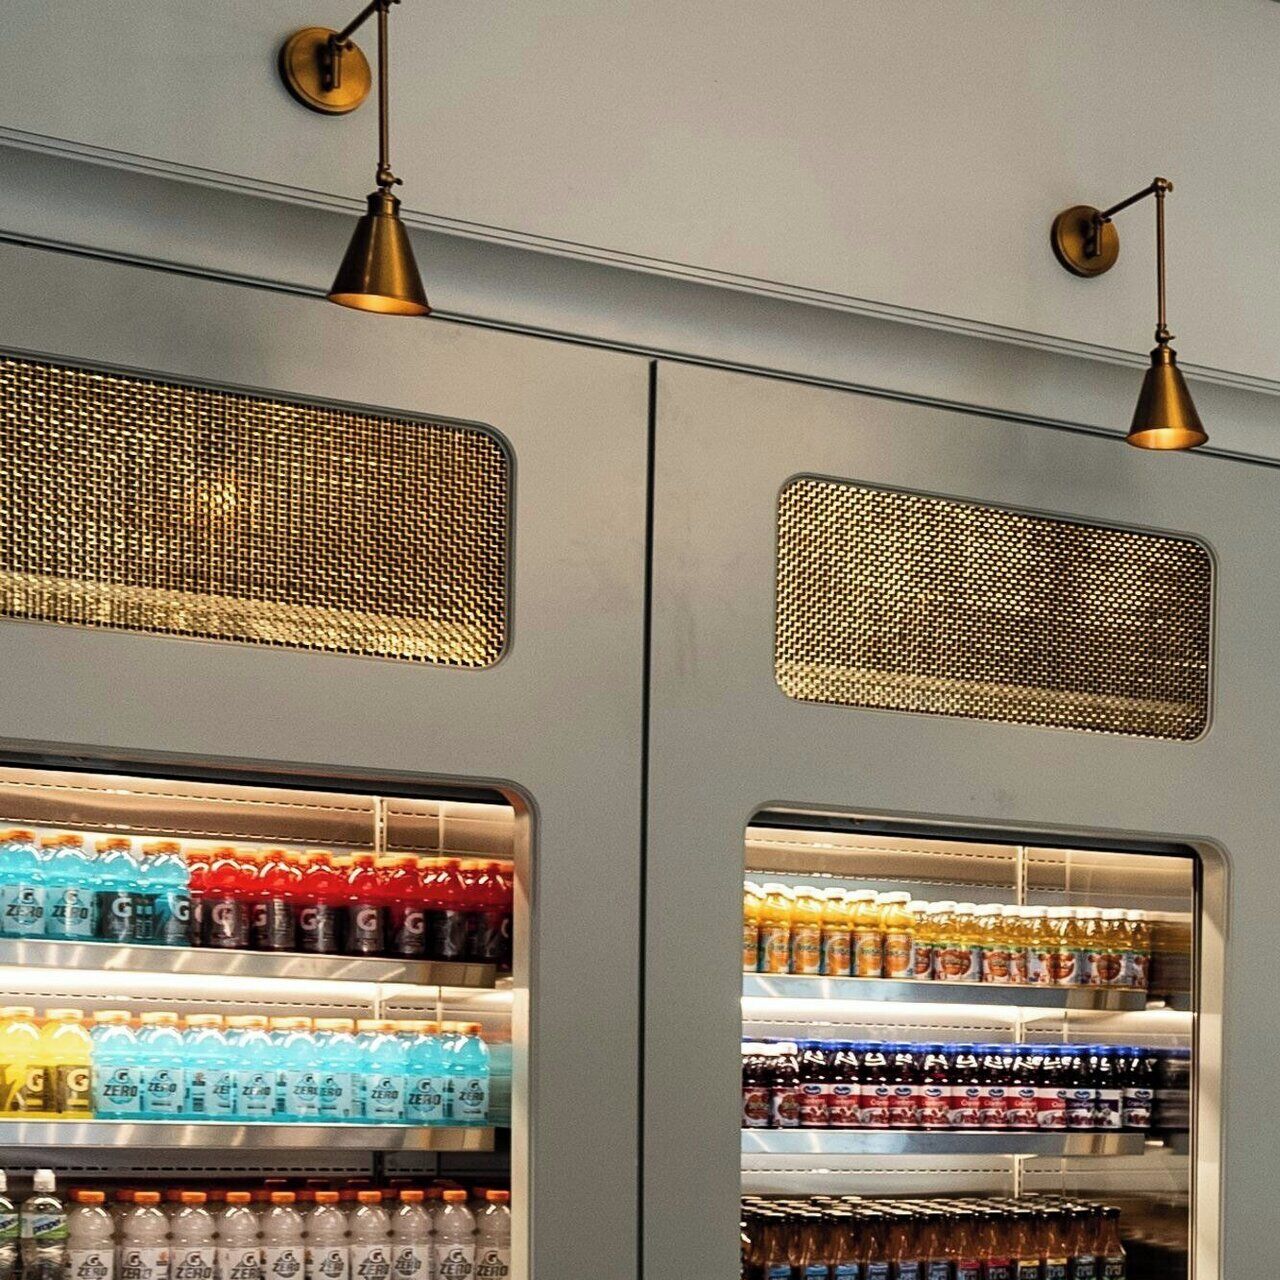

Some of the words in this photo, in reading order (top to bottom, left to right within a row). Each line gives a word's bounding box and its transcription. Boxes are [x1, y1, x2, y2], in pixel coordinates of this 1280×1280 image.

[357, 908, 376, 930] G
[67, 1068, 89, 1092] G
[102, 1084, 138, 1097] ZERO
[77, 1266, 108, 1277] ZERO
[176, 1267, 211, 1280] ZERO
[477, 1264, 508, 1277] ZERO
